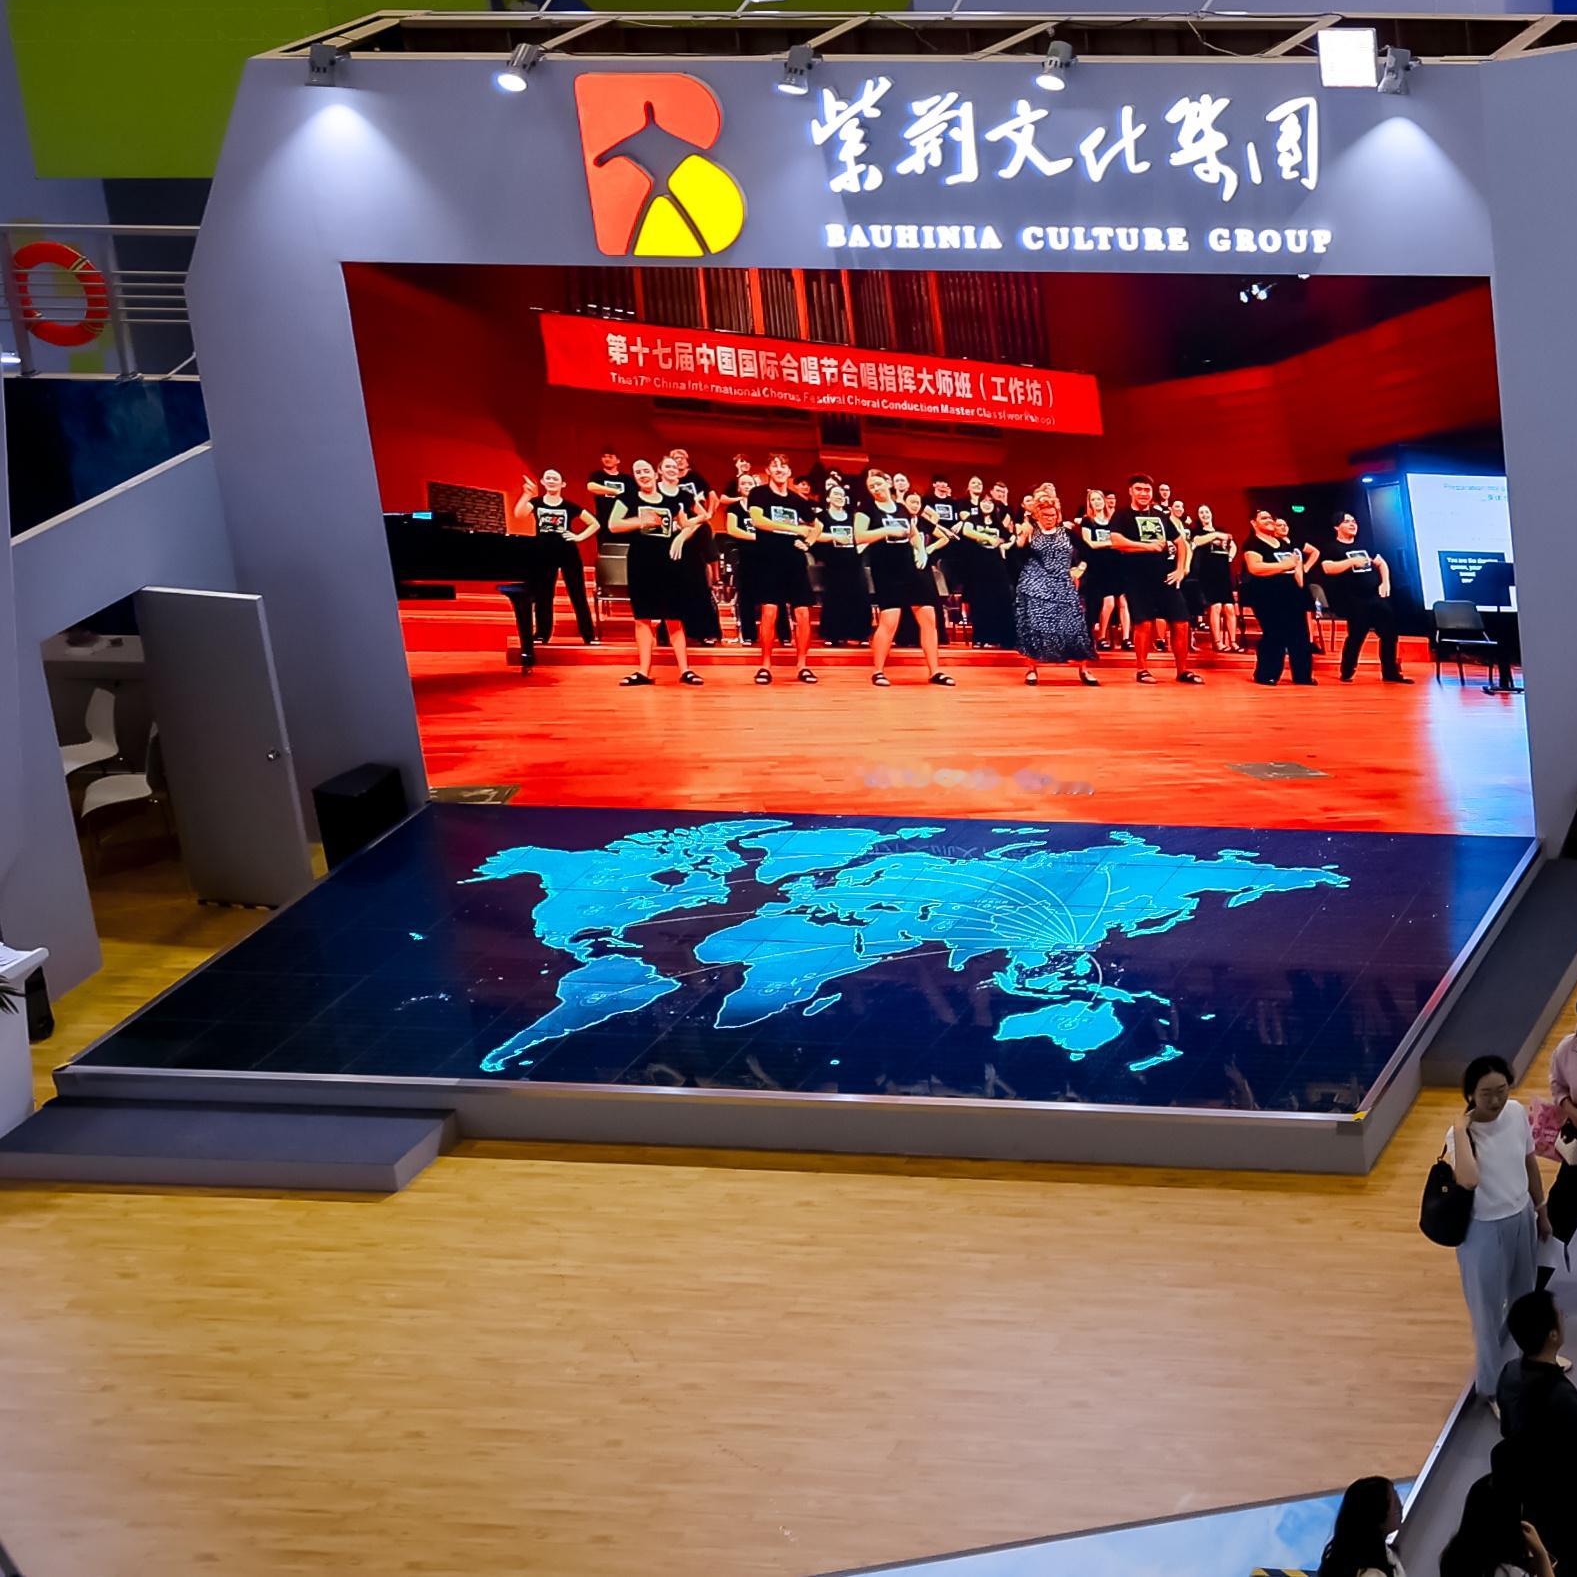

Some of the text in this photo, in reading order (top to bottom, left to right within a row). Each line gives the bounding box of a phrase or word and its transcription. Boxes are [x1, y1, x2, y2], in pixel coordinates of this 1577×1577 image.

[811, 75, 1320, 202] 紫荆文化集团
[826, 222, 1333, 256] BAUHINIA CULTURE GROUP
[653, 377, 686, 391] China
[762, 387, 801, 402] Chorus
[847, 395, 880, 409] Choral
[881, 398, 940, 414] Conduction
[940, 403, 976, 417] Master
